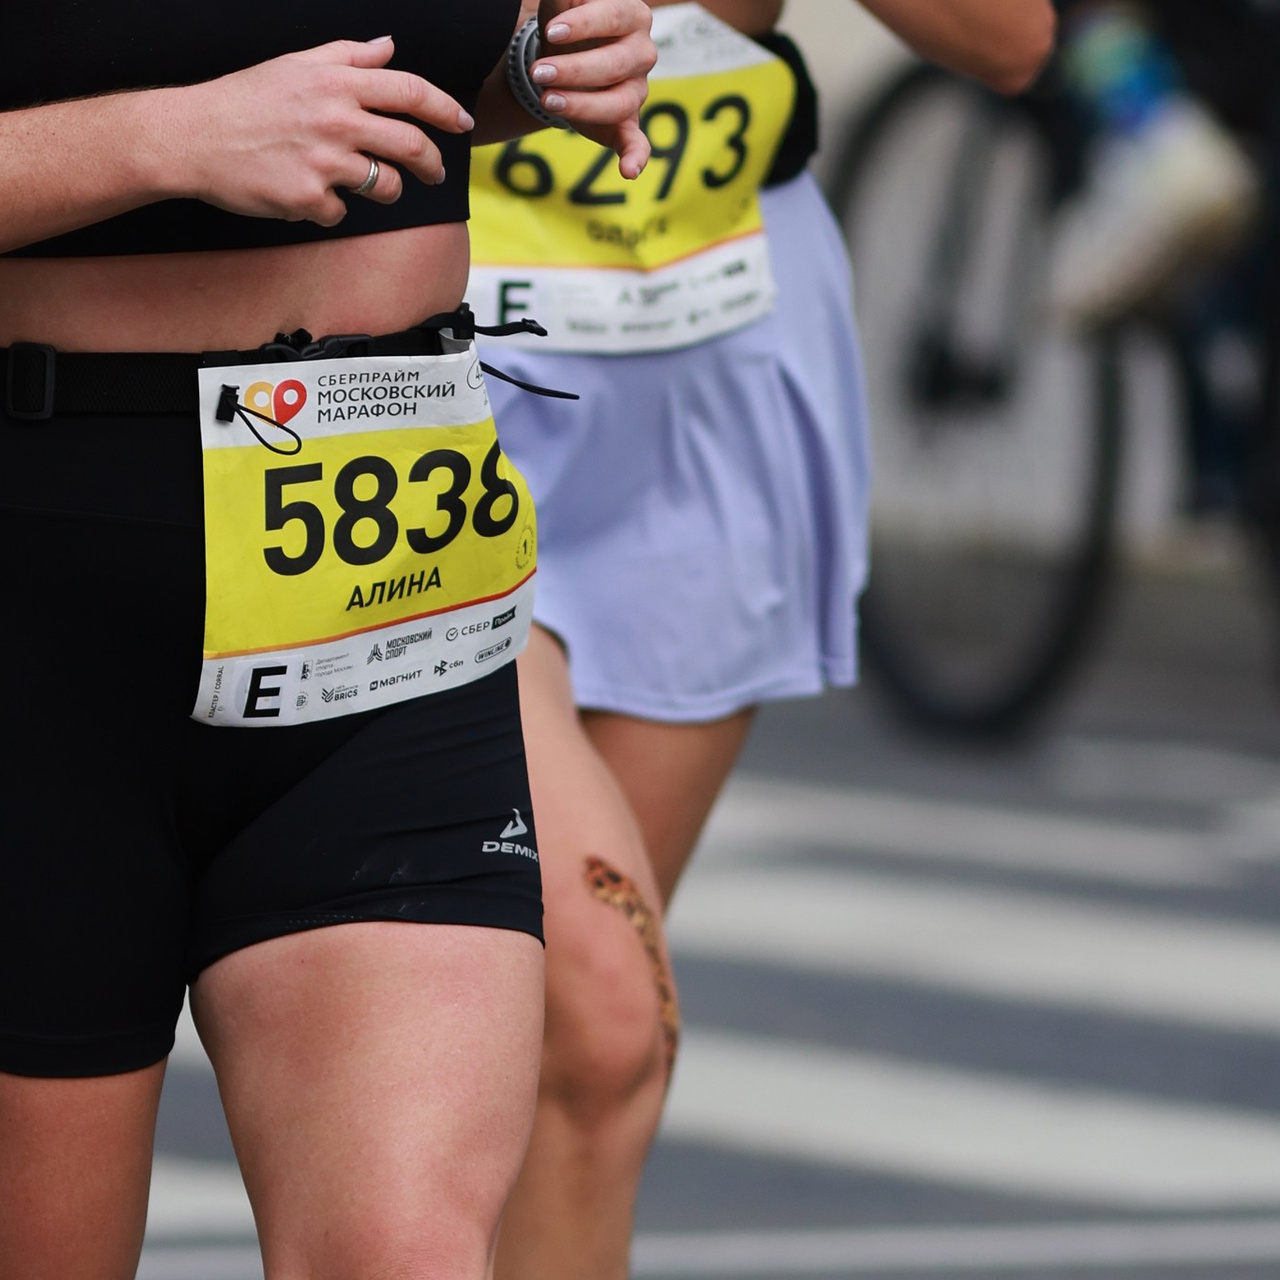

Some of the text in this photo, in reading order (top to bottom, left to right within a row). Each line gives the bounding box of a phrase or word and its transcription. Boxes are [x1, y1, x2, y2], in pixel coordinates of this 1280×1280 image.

[494, 95, 752, 206] 6293
[317, 370, 421, 387] СБЕРПРАЙМ
[317, 381, 456, 407] МОСКОВСКИЙ
[317, 402, 418, 424] МАРАФОН
[263, 438, 519, 576] 5838
[345, 566, 442, 611] АЛИНА
[385, 627, 433, 650] МОСКОВСКИЙ
[461, 620, 491, 636] СБЕР
[385, 645, 407, 661] СПОРТ
[334, 688, 358, 701] BRICS
